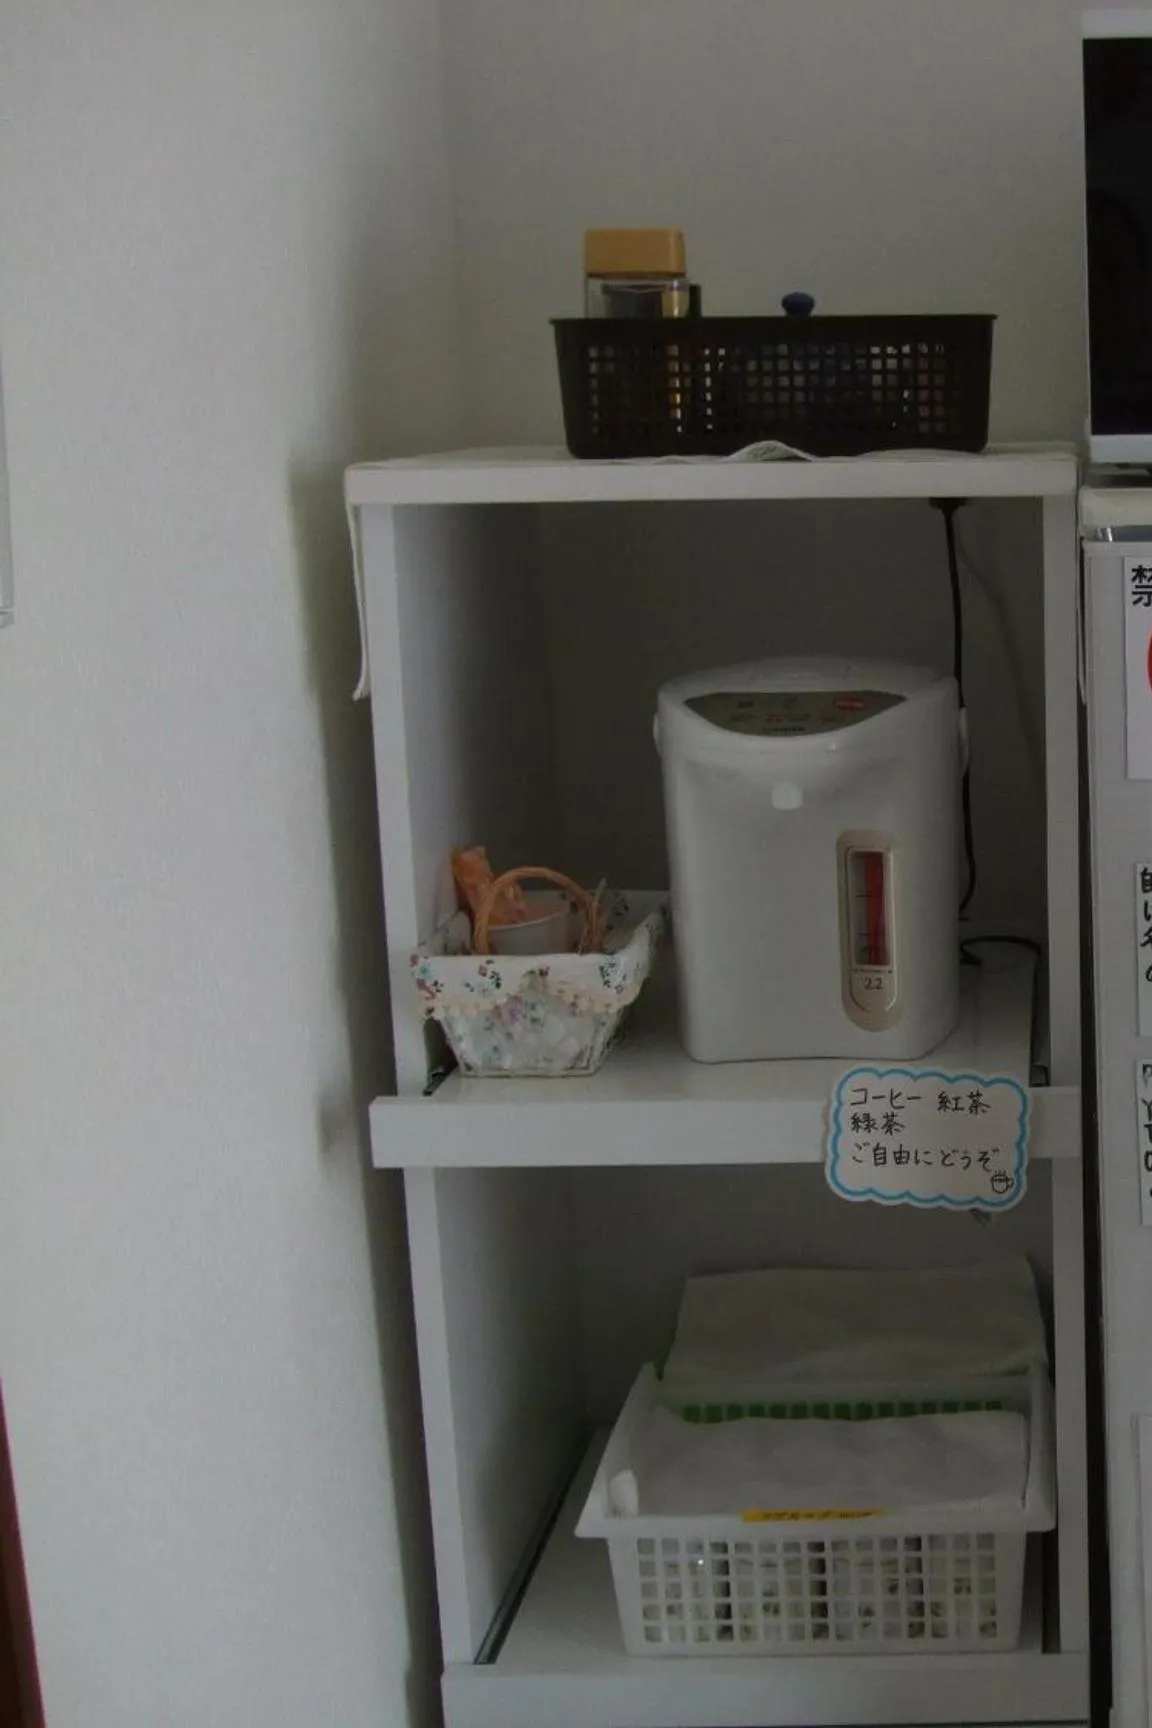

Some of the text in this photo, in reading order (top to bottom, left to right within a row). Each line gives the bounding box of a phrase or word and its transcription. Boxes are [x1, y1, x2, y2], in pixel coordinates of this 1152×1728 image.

[850, 1087, 992, 1116] コーヒー 紅茶
[850, 1112, 906, 1136] 緑茶
[851, 1142, 1000, 1172] ご自由にどうぞ
